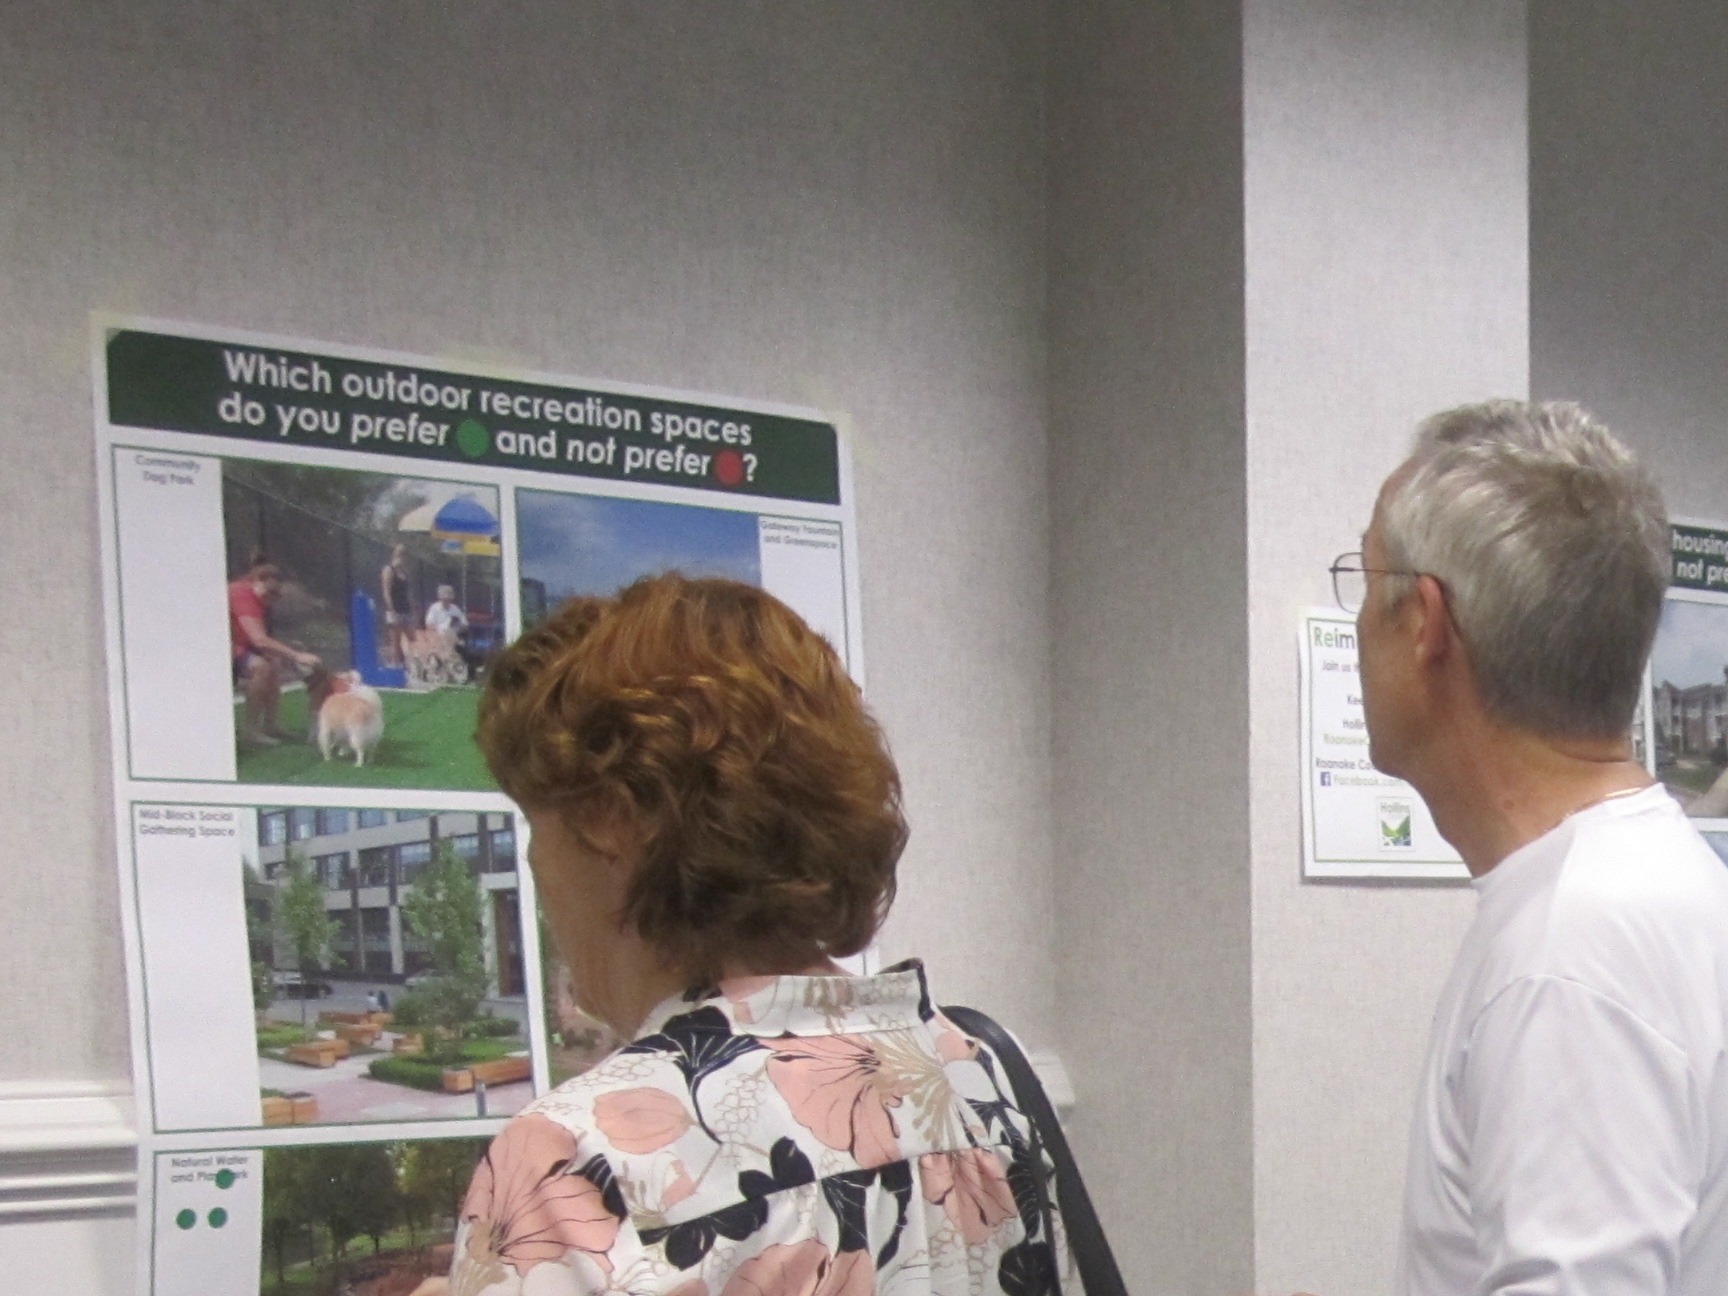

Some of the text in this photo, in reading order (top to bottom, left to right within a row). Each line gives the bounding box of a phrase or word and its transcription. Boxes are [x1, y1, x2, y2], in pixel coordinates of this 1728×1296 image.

[218, 391, 266, 425] do
[275, 404, 340, 436] you
[351, 412, 449, 446] prefer
[495, 429, 556, 458] and
[566, 436, 616, 465] not
[624, 444, 711, 476] prefer
[223, 349, 751, 445] Which outdoor recreation spaces
[1676, 559, 1704, 579] not
